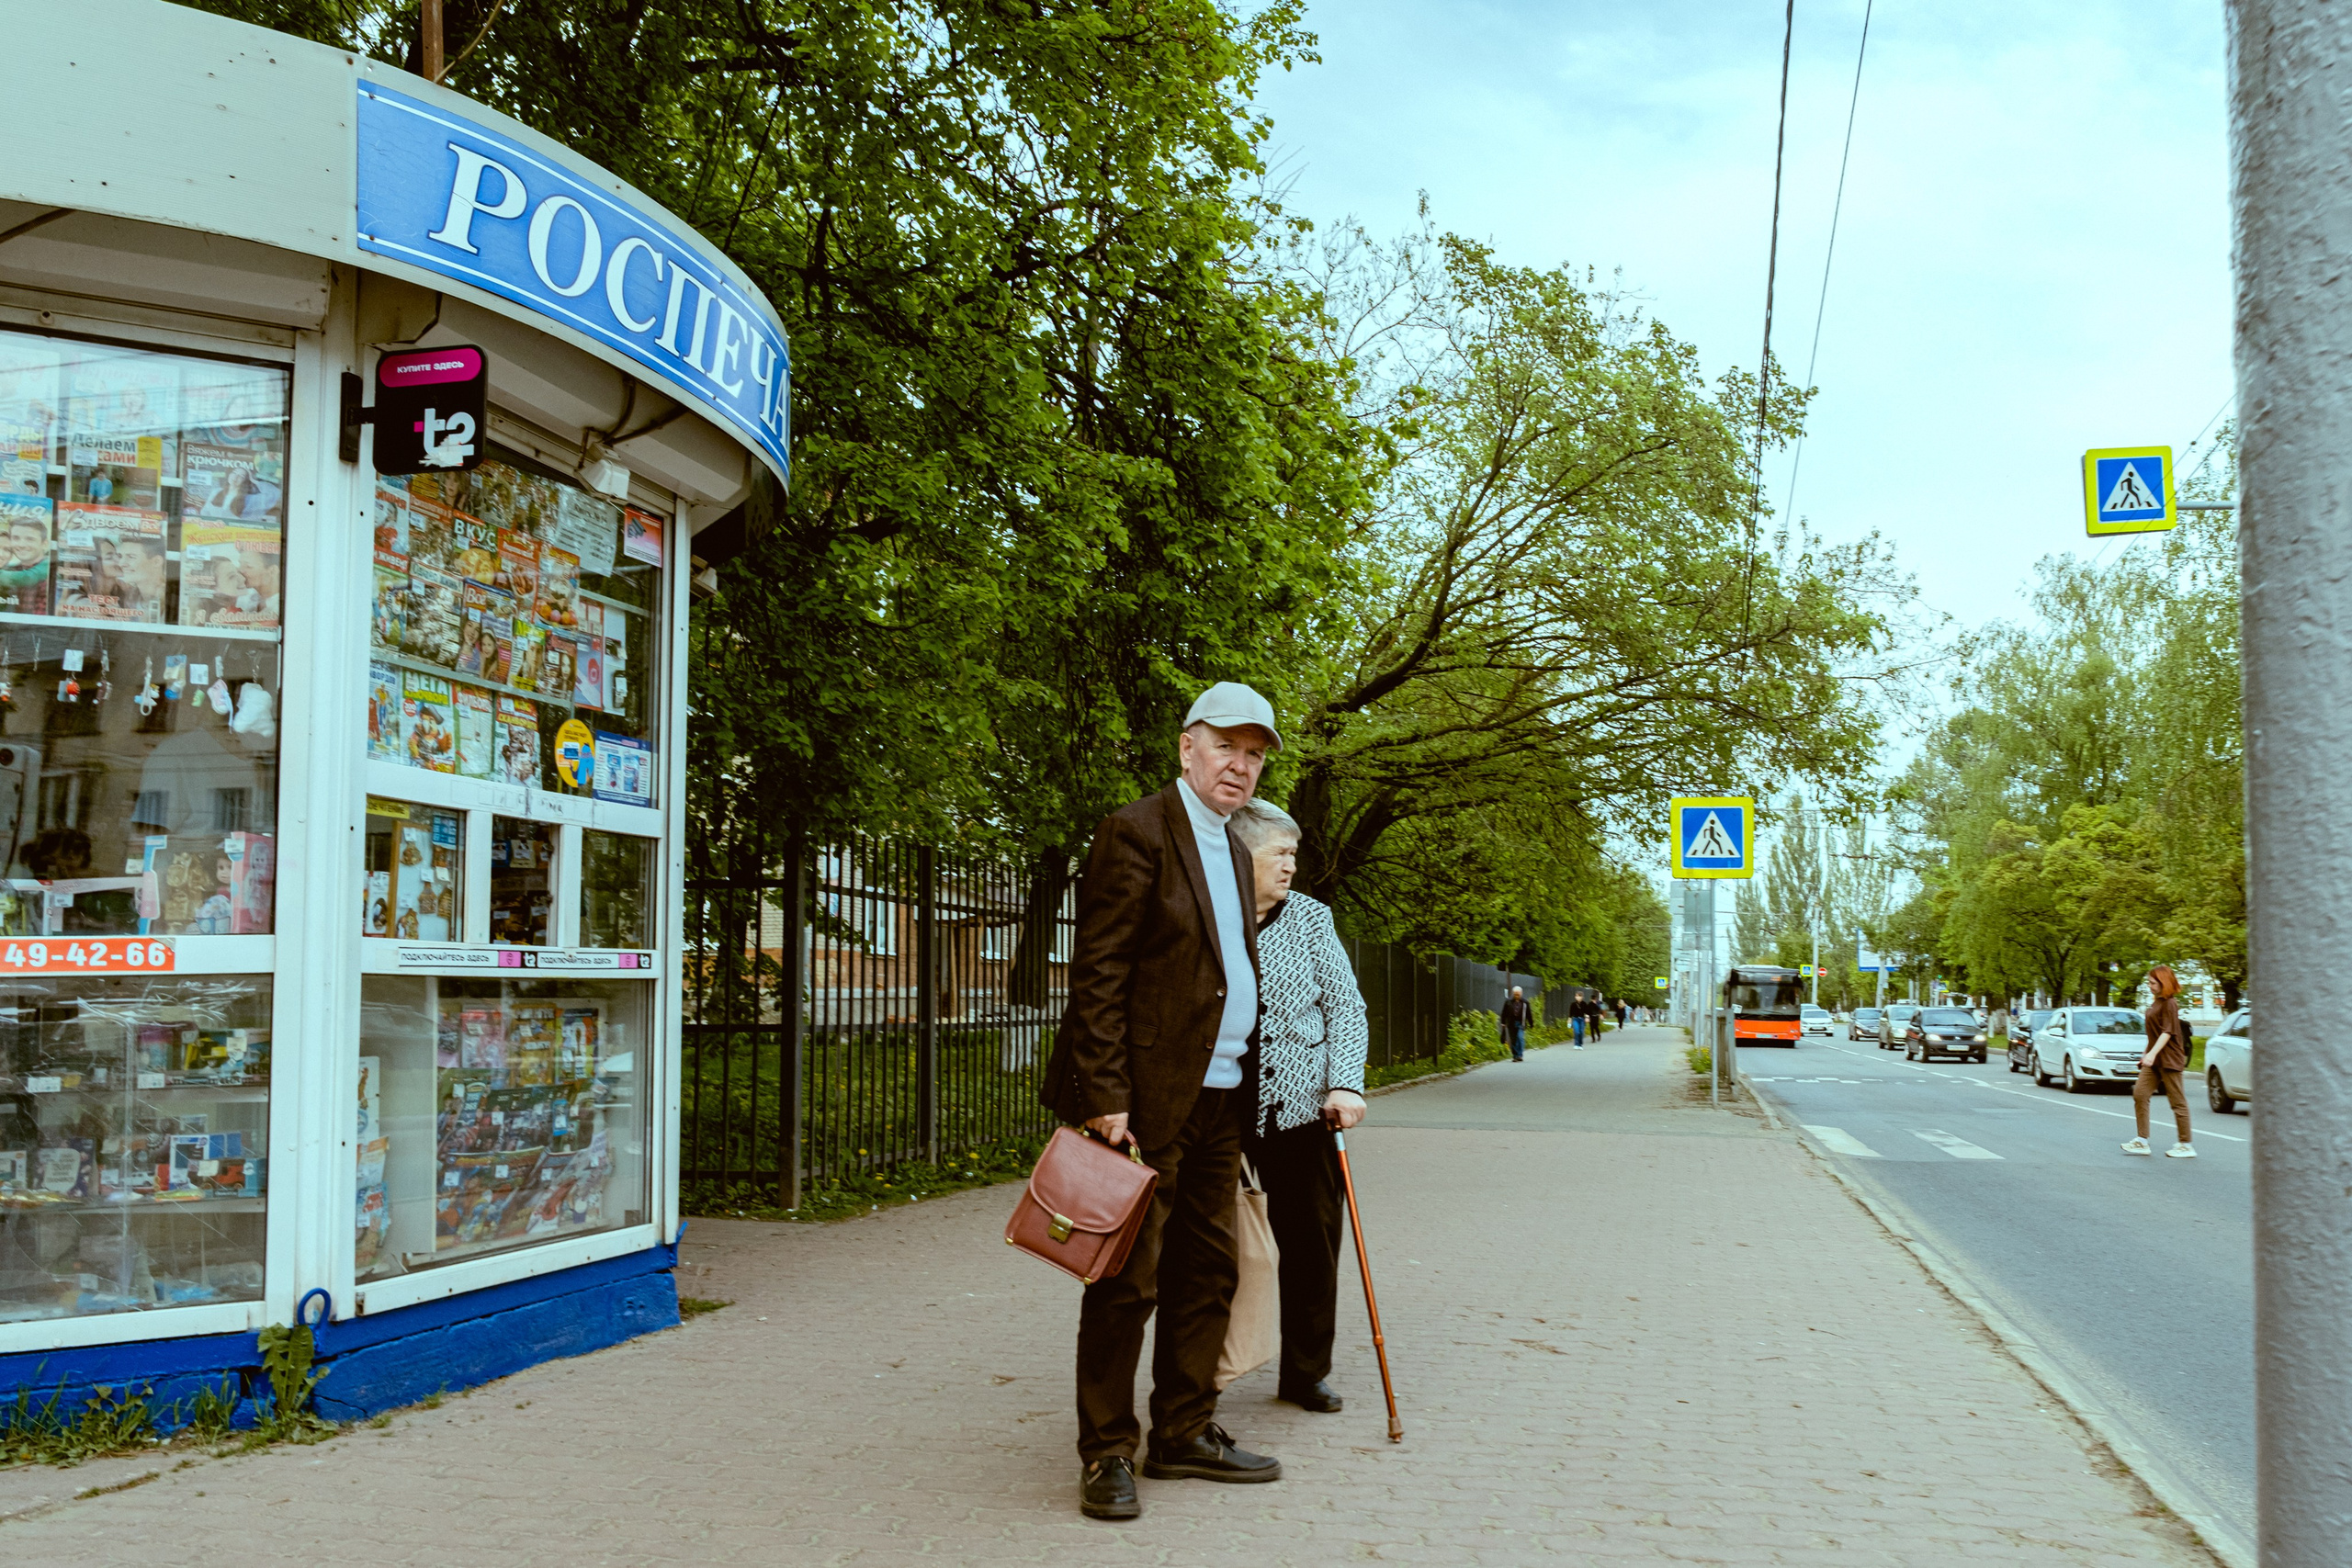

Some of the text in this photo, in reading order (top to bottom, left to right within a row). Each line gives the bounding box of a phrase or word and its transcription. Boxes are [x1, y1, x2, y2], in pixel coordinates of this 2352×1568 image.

[397, 361, 464, 373] КУПИТЕ ЗДЕСЬ
[187, 445, 225, 458] Вяжем
[187, 456, 254, 471] крючком
[454, 519, 496, 547] ВКУС
[88, 594, 119, 605] ТЕСТ
[62, 604, 144, 616] НА НАСТОЯЩЕГО
[5, 942, 166, 967] 49-42-66
